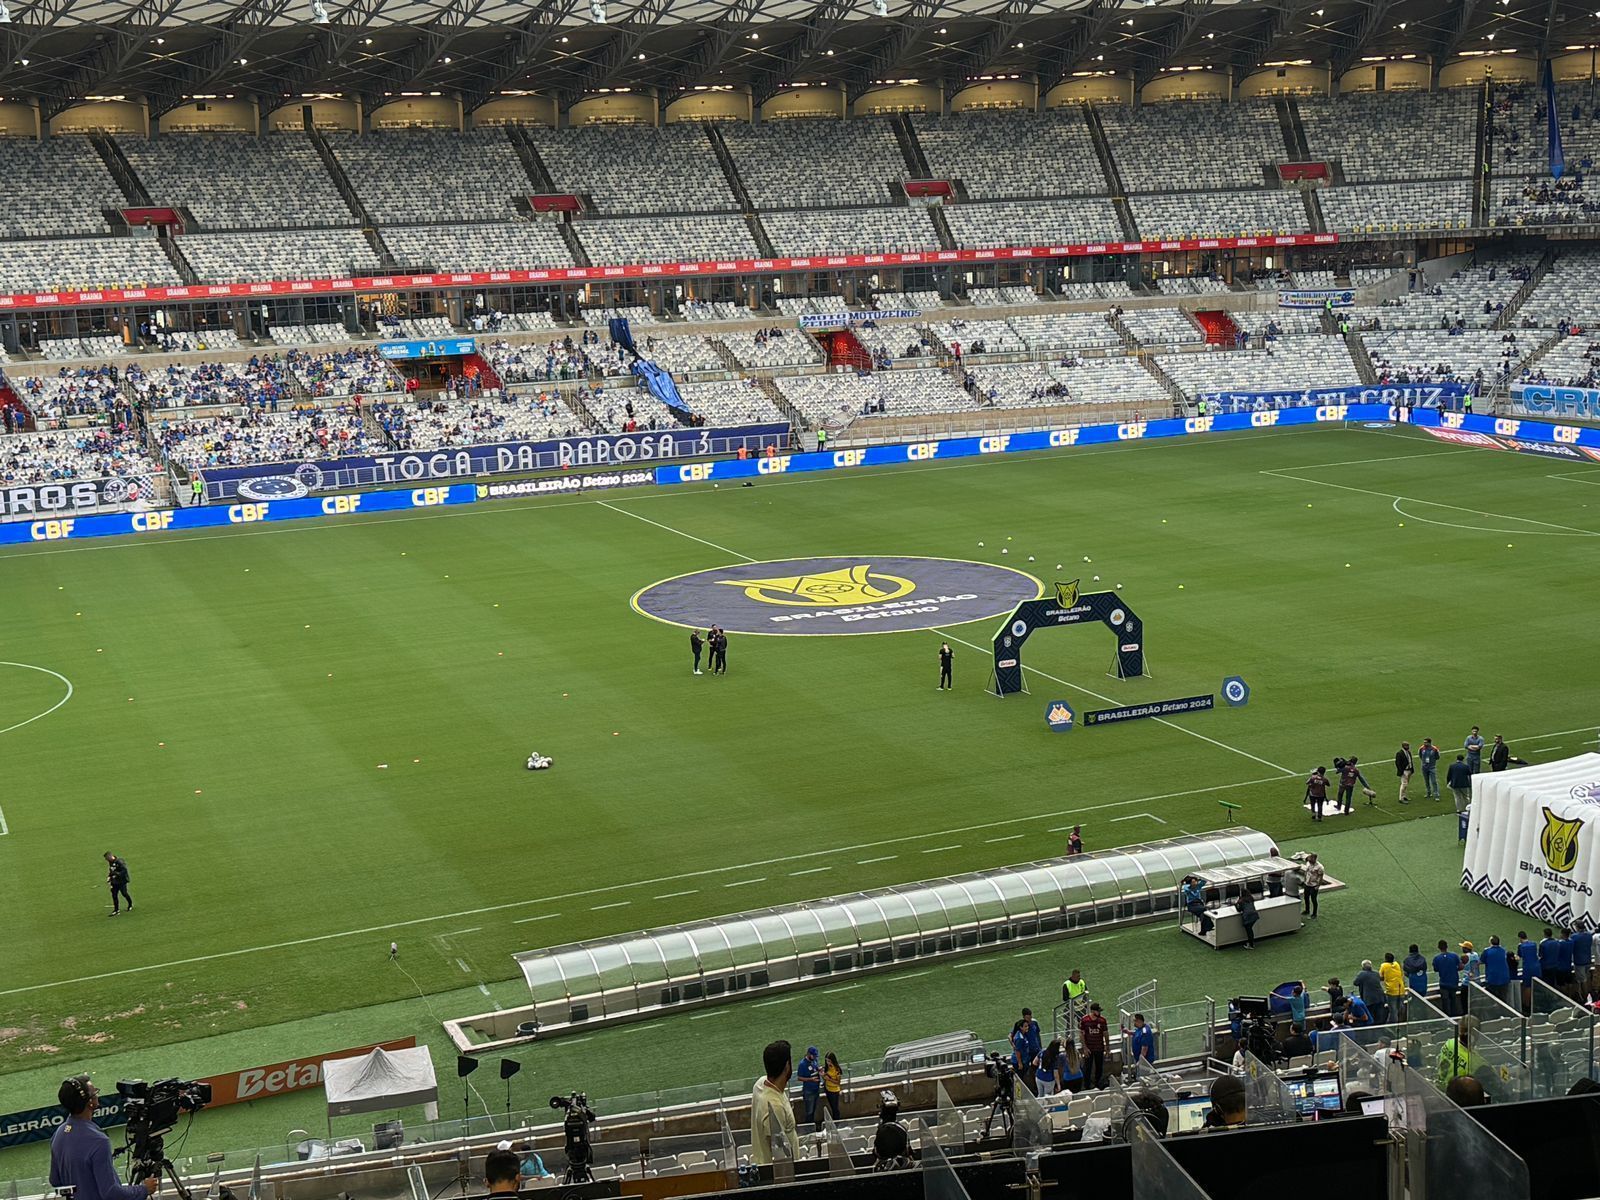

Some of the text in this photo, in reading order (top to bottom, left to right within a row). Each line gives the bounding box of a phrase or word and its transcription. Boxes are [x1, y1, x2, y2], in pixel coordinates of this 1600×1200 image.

[680, 405, 1348, 481] CBF CBF CBF CBF CBF CBF CBF CBF CBF CBF
[1495, 419, 1521, 435] CBF
[1553, 426, 1581, 443] CBF
[375, 452, 472, 481] TOCA
[497, 446, 532, 471] DA
[700, 431, 710, 452] 3
[489, 476, 580, 496] BRASILEIRÃO
[622, 471, 653, 484] 2024
[31, 487, 449, 540] CBF CBF CBF CBF CBF
[769, 594, 978, 622] BRASILEIRÃO
[840, 606, 939, 622] Betano
[1045, 605, 1091, 616] BRASILEIRÃO
[1058, 614, 1080, 622] Betano
[1097, 699, 1211, 721] BRASILEIRÃO Betano 2024
[236, 1062, 323, 1099] Beta
[0, 1115, 65, 1137] LEIRÃO
[93, 1104, 119, 1118] ano
